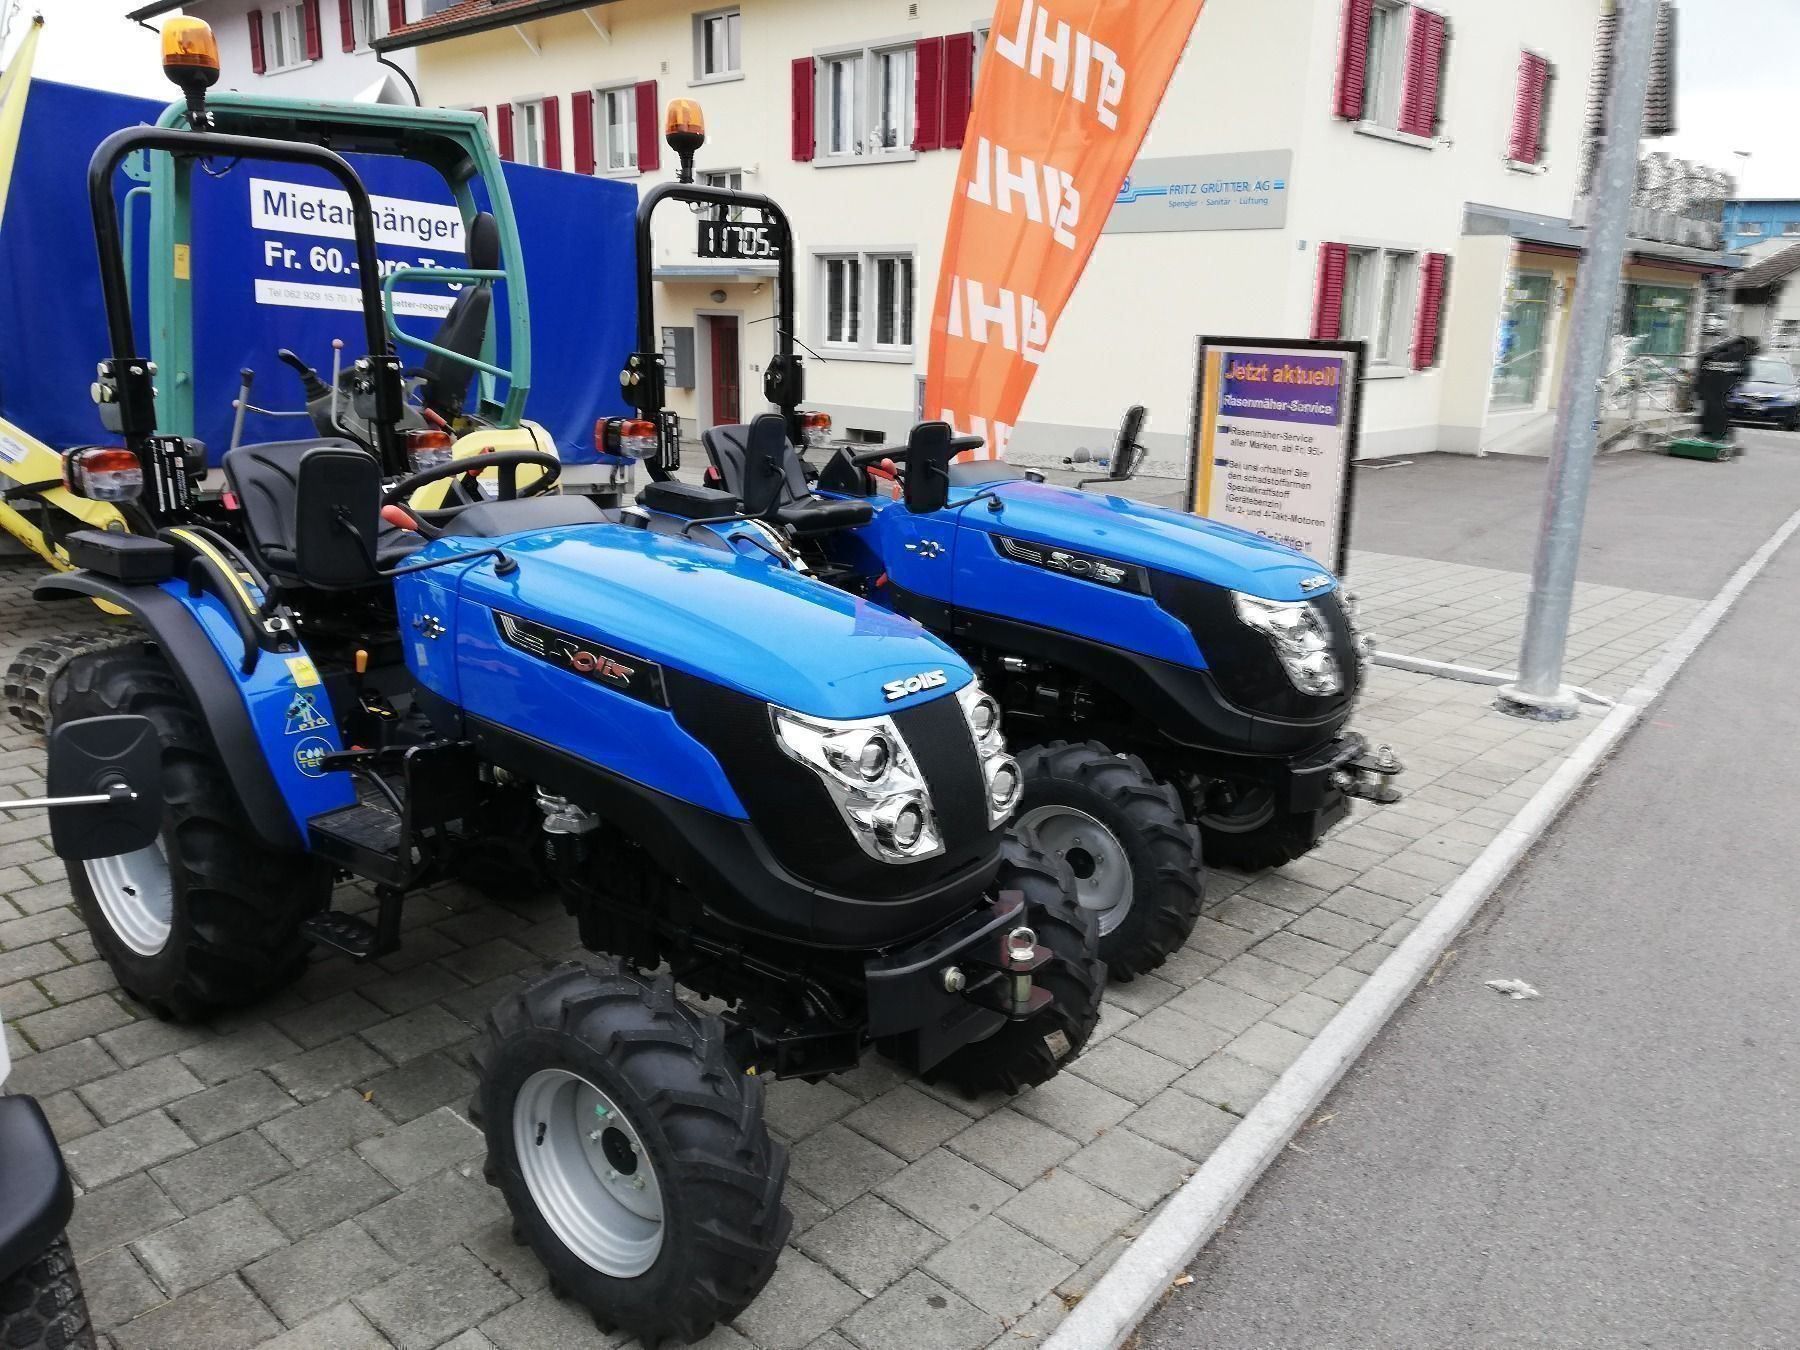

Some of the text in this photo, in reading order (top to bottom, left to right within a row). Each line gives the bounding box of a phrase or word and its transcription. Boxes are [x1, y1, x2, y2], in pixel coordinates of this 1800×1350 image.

[1169, 180, 1270, 195] FRITZ GRÜTTER AG
[1168, 200, 1198, 208] Spengler
[264, 240, 302, 269] Fr.
[1224, 360, 1337, 386] Jetzt aktuell
[1223, 394, 1333, 415] Rasenmäher-Service
[1231, 426, 1314, 443] Rasenmäher-Service
[1227, 471, 1242, 480] den
